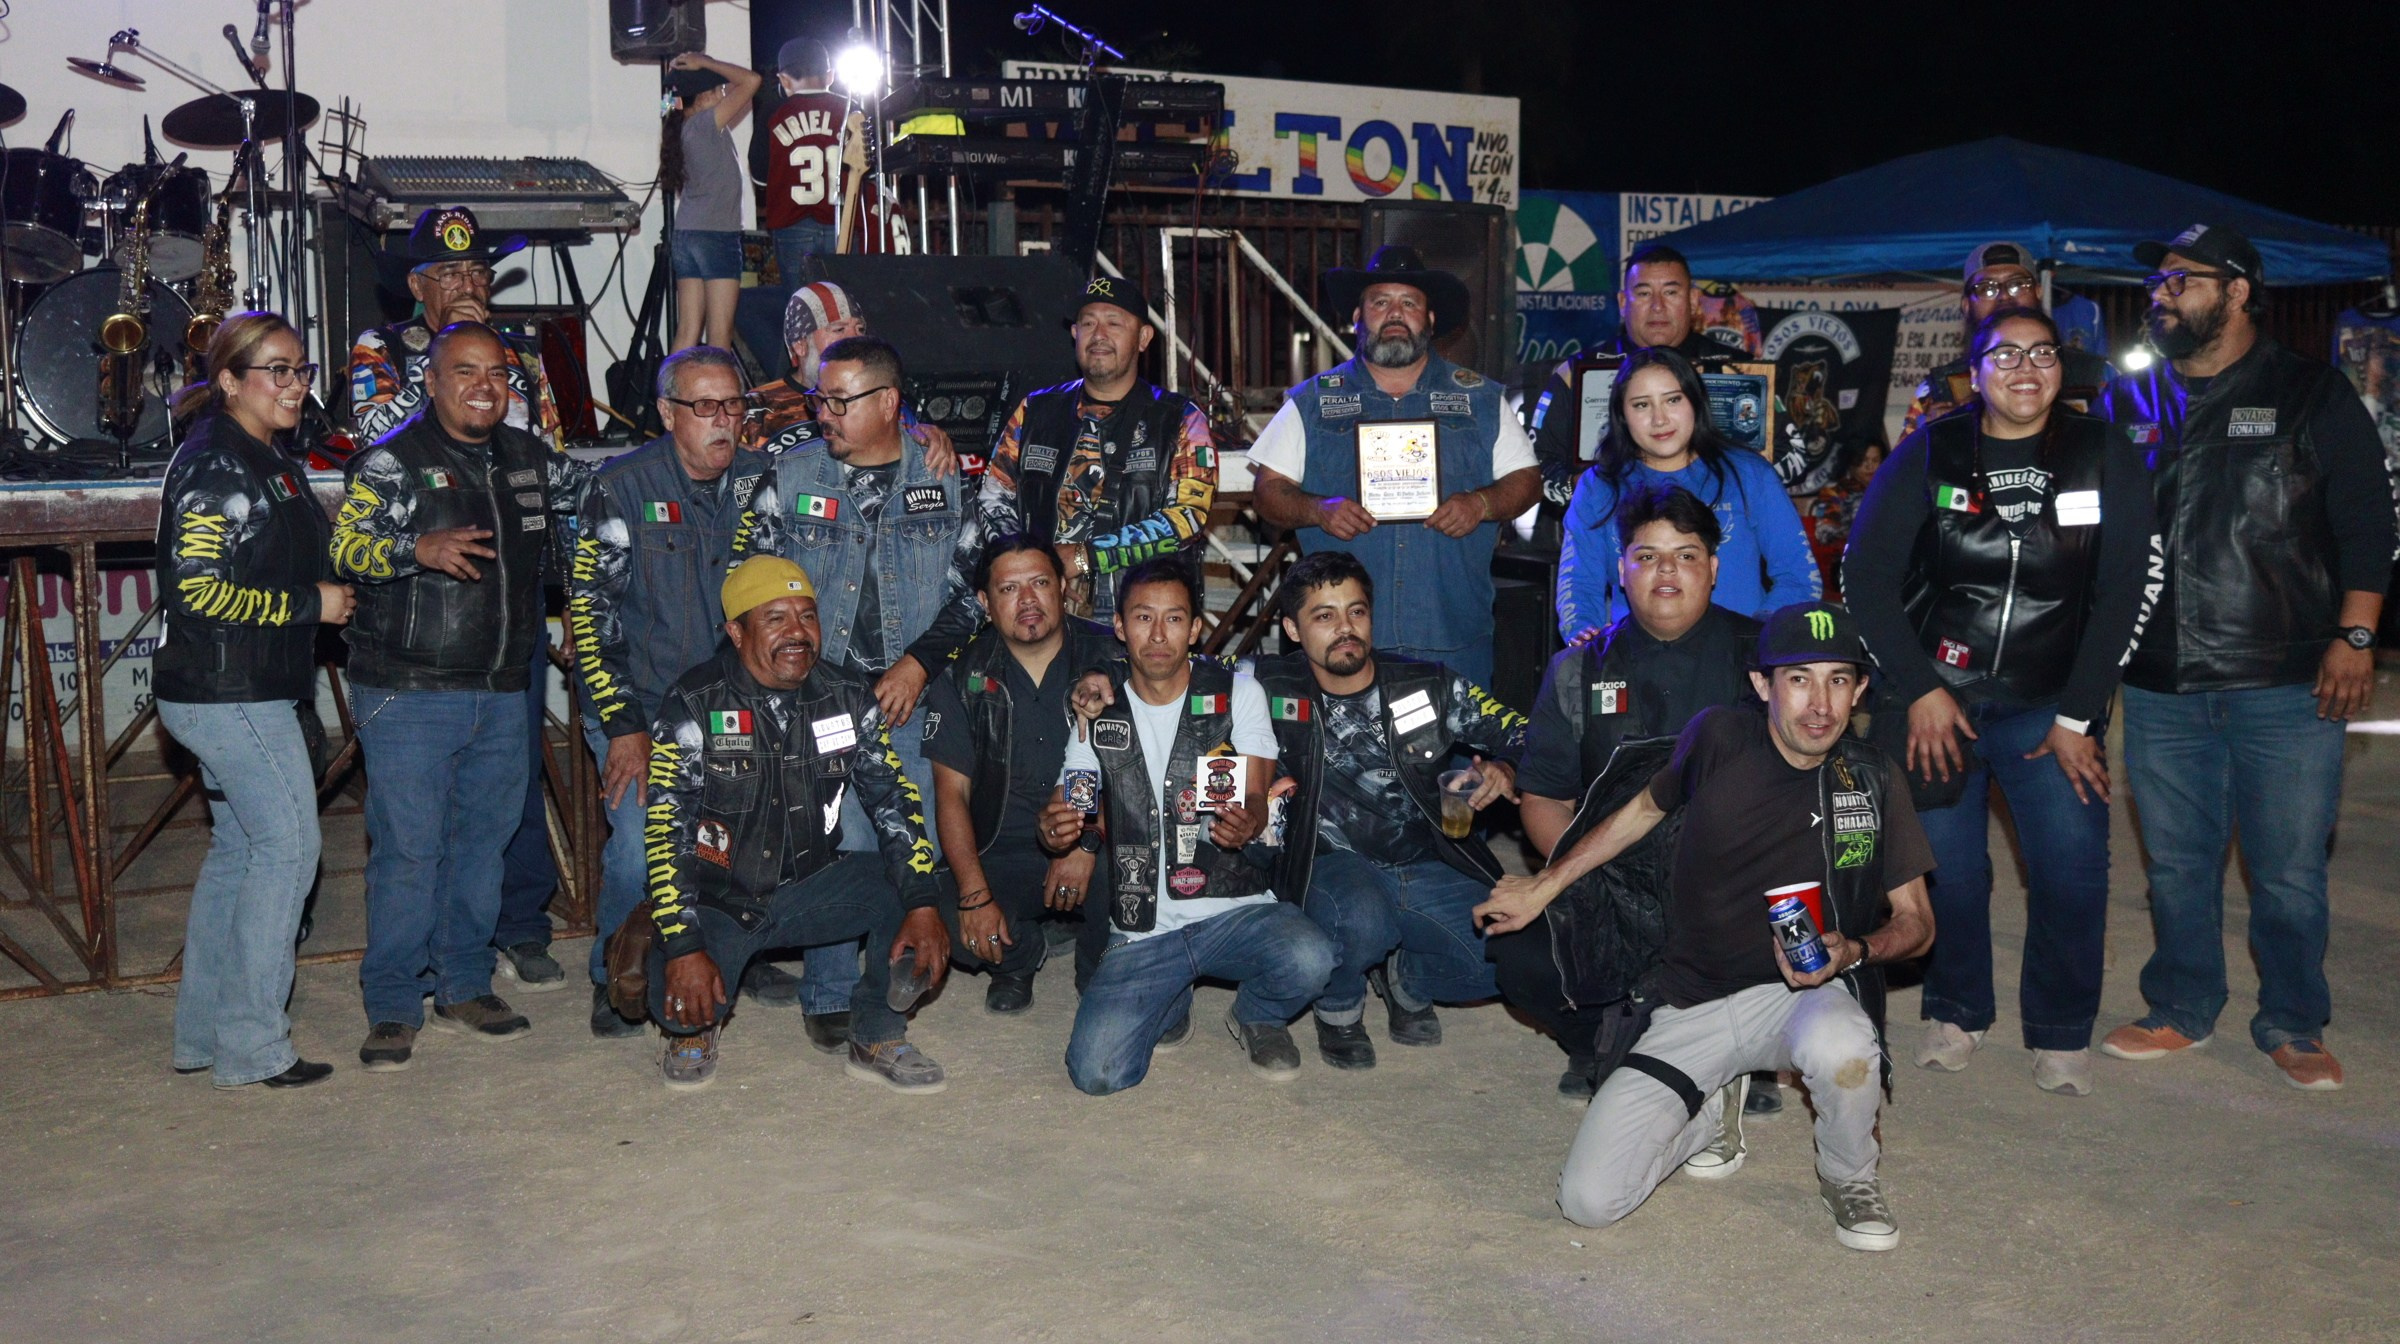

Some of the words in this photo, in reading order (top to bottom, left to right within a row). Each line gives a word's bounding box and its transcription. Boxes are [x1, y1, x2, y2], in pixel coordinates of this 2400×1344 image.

[773, 110, 833, 147] URIEL
[1477, 132, 1510, 156] NVO.
[790, 145, 842, 205] 31
[1515, 294, 1606, 311] INSTALACIONES
[1767, 320, 1800, 356] OSOS
[1322, 396, 1359, 404] PERALTA
[2234, 410, 2274, 421] NOVATOS
[734, 477, 760, 492] NOVATO
[907, 490, 942, 505] NOVATOS
[907, 500, 944, 512] Sergio
[178, 511, 228, 560] MX
[1591, 681, 1627, 691] MÉXICO
[1096, 721, 1128, 735] NOVATOS
